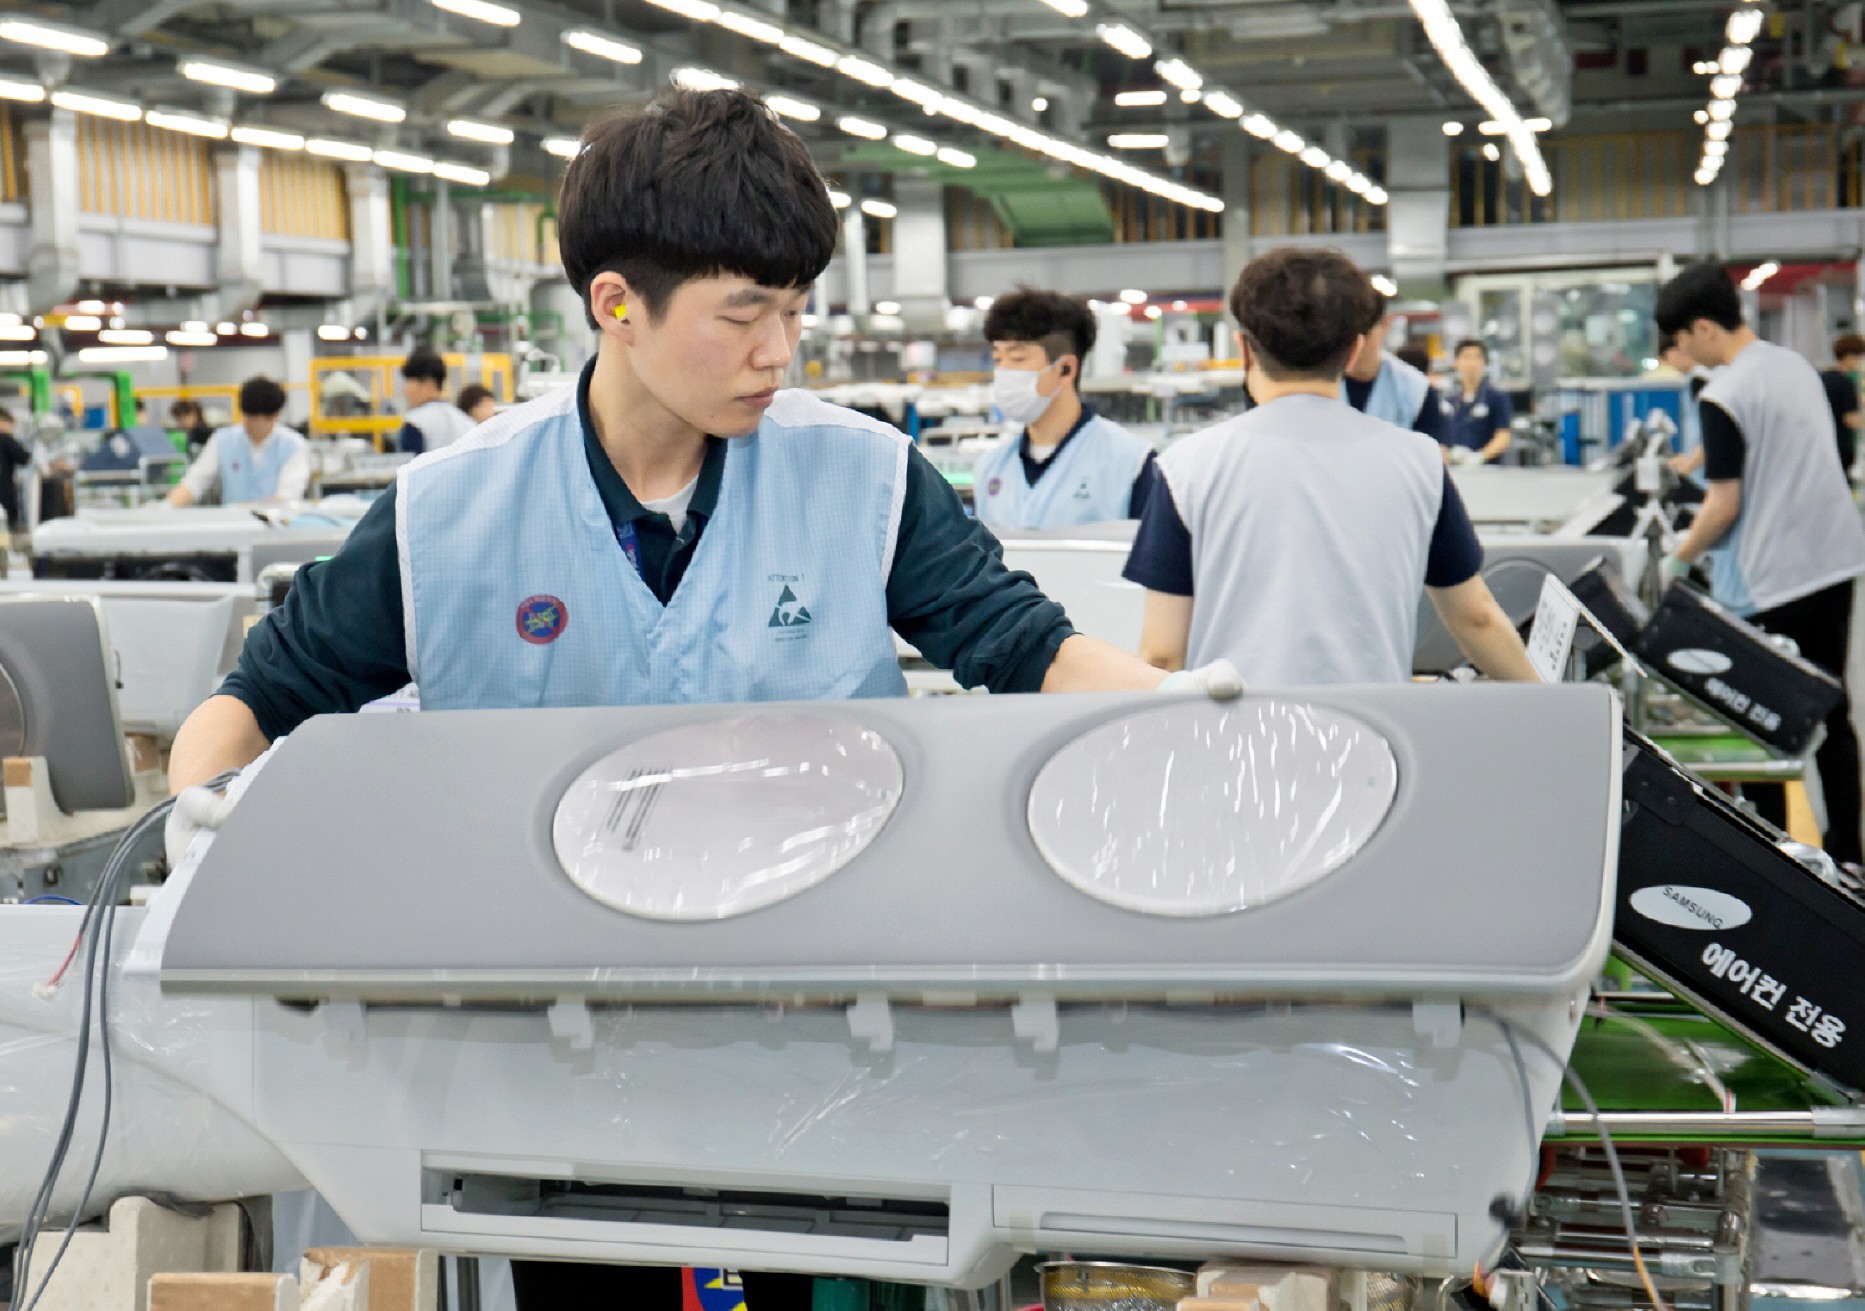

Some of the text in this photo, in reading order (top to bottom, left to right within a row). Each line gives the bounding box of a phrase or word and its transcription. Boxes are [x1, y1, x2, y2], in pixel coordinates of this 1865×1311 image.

[1662, 886, 1724, 930] SAMSUNG
[1702, 942, 1847, 1049] 에어컨 전용
